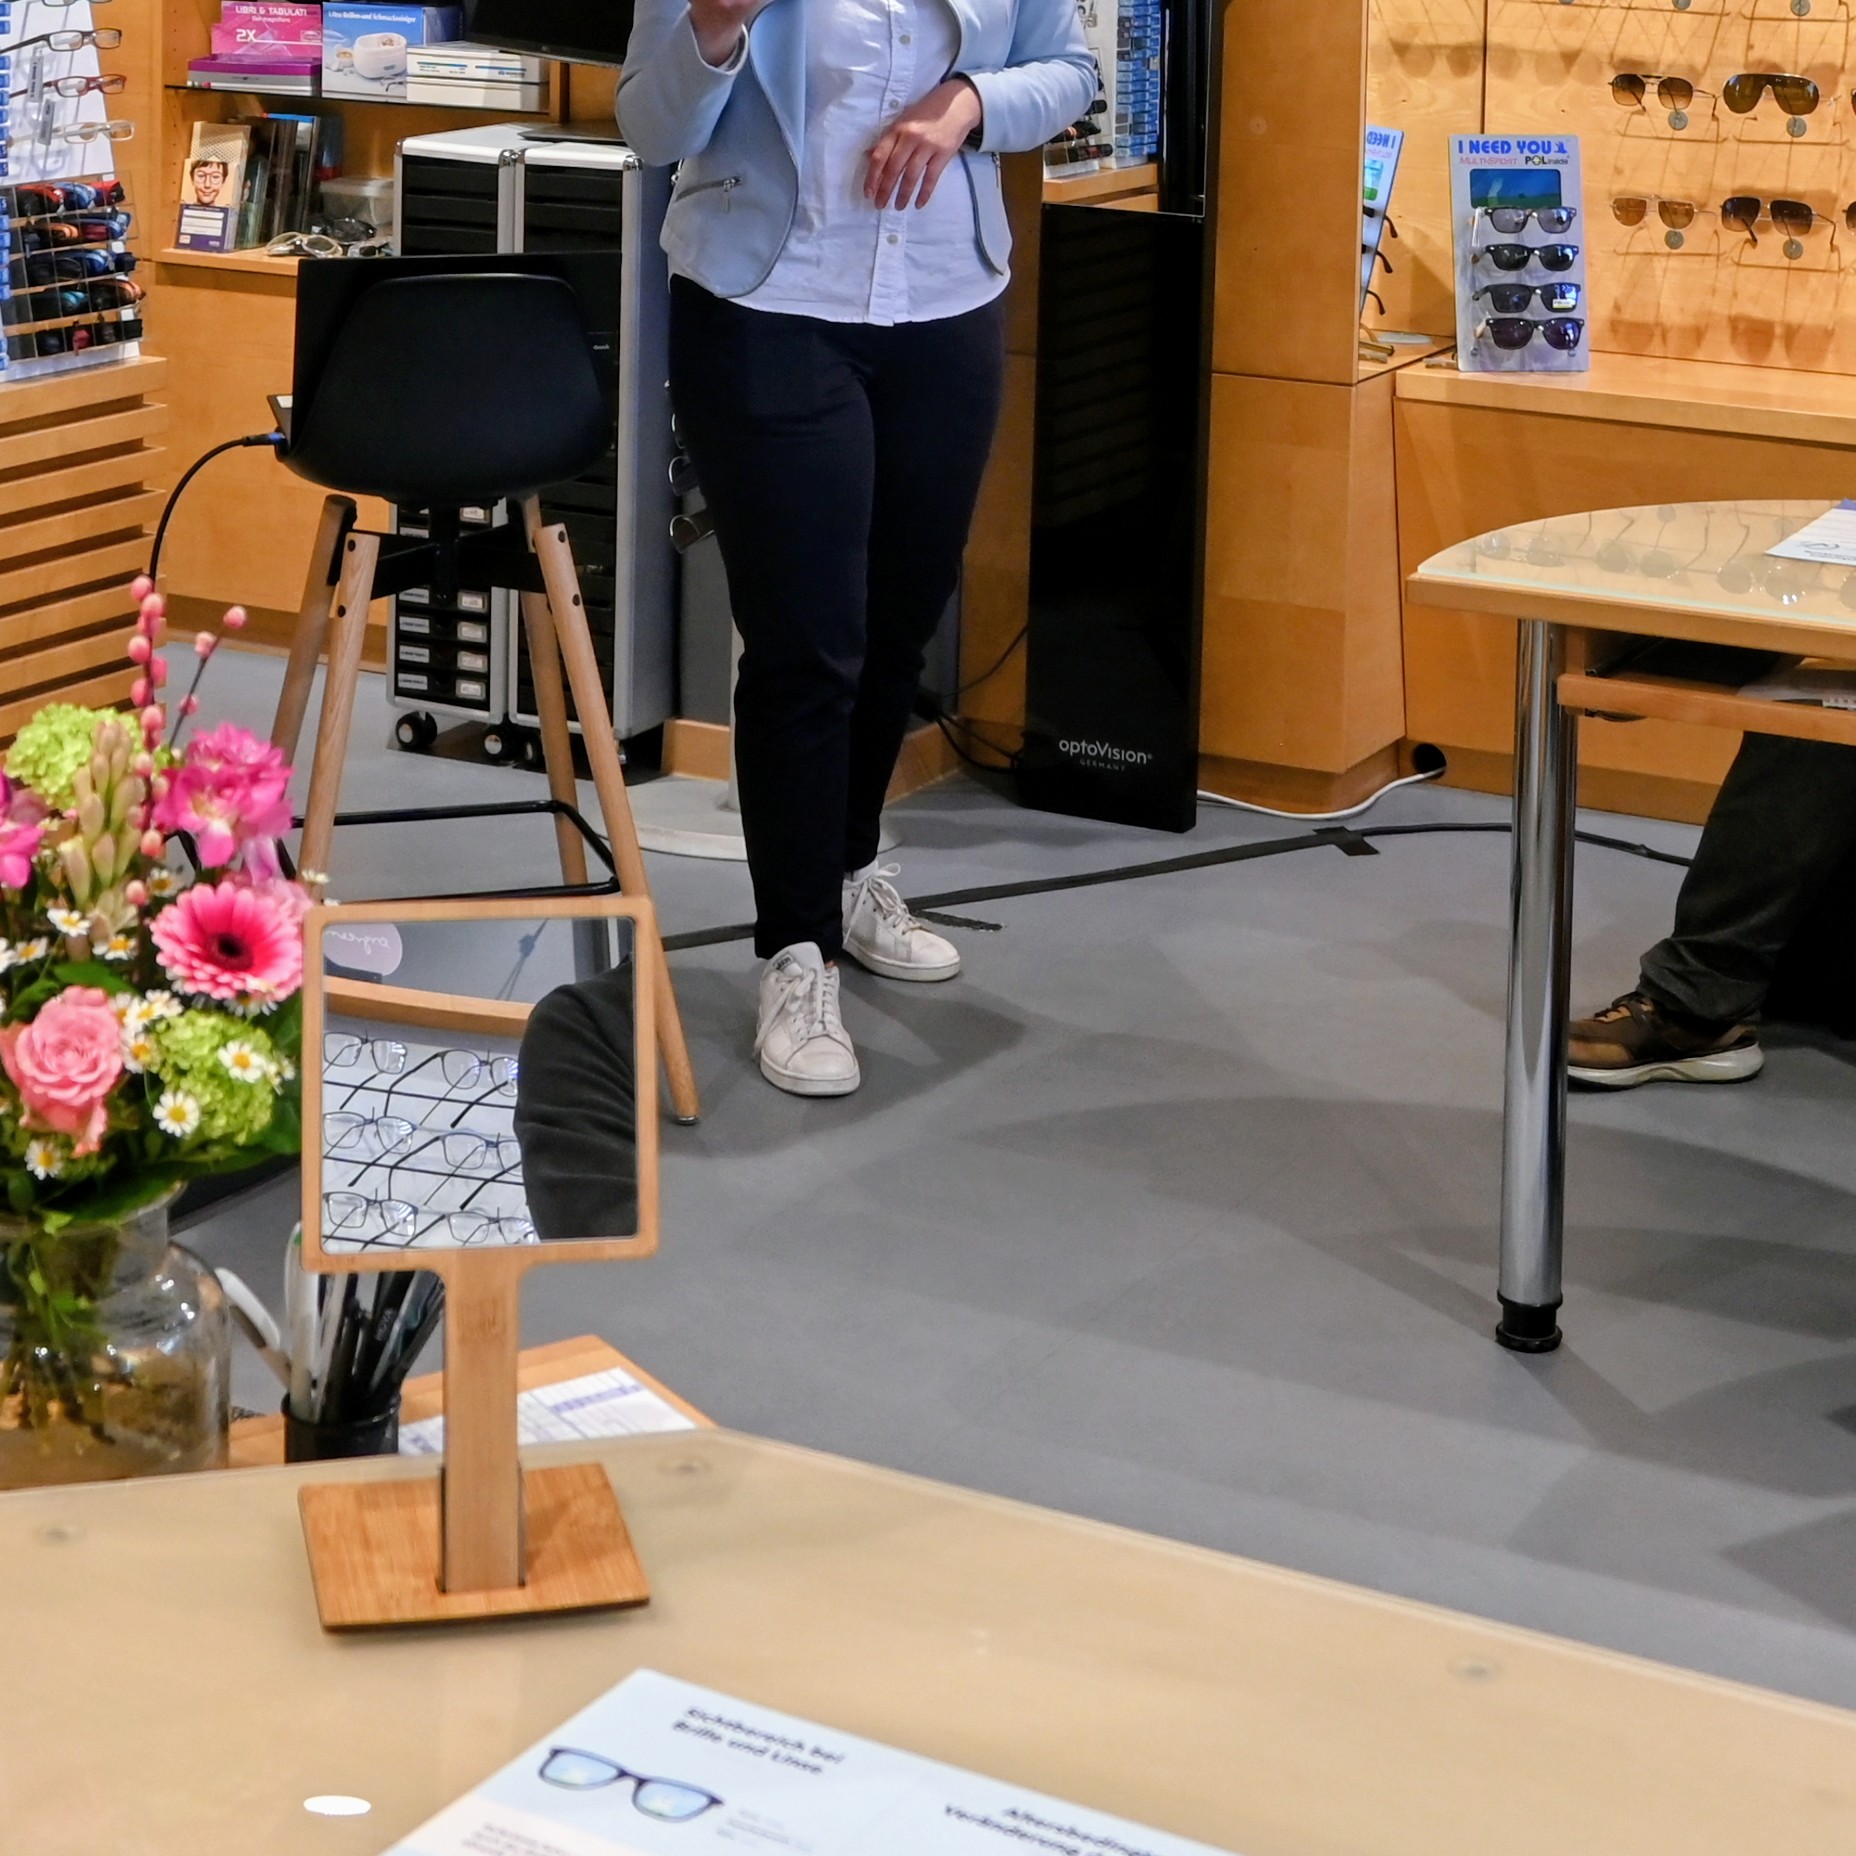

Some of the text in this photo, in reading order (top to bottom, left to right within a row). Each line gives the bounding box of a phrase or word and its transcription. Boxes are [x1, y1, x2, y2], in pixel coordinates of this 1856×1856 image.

[235, 5, 257, 14] LIBRI
[268, 6, 308, 17] TABULATI
[236, 28, 256, 43] 2X
[1458, 140, 1552, 154] I NEED YOU
[727, 1739, 769, 1757] und
[810, 1746, 846, 1764] bei
